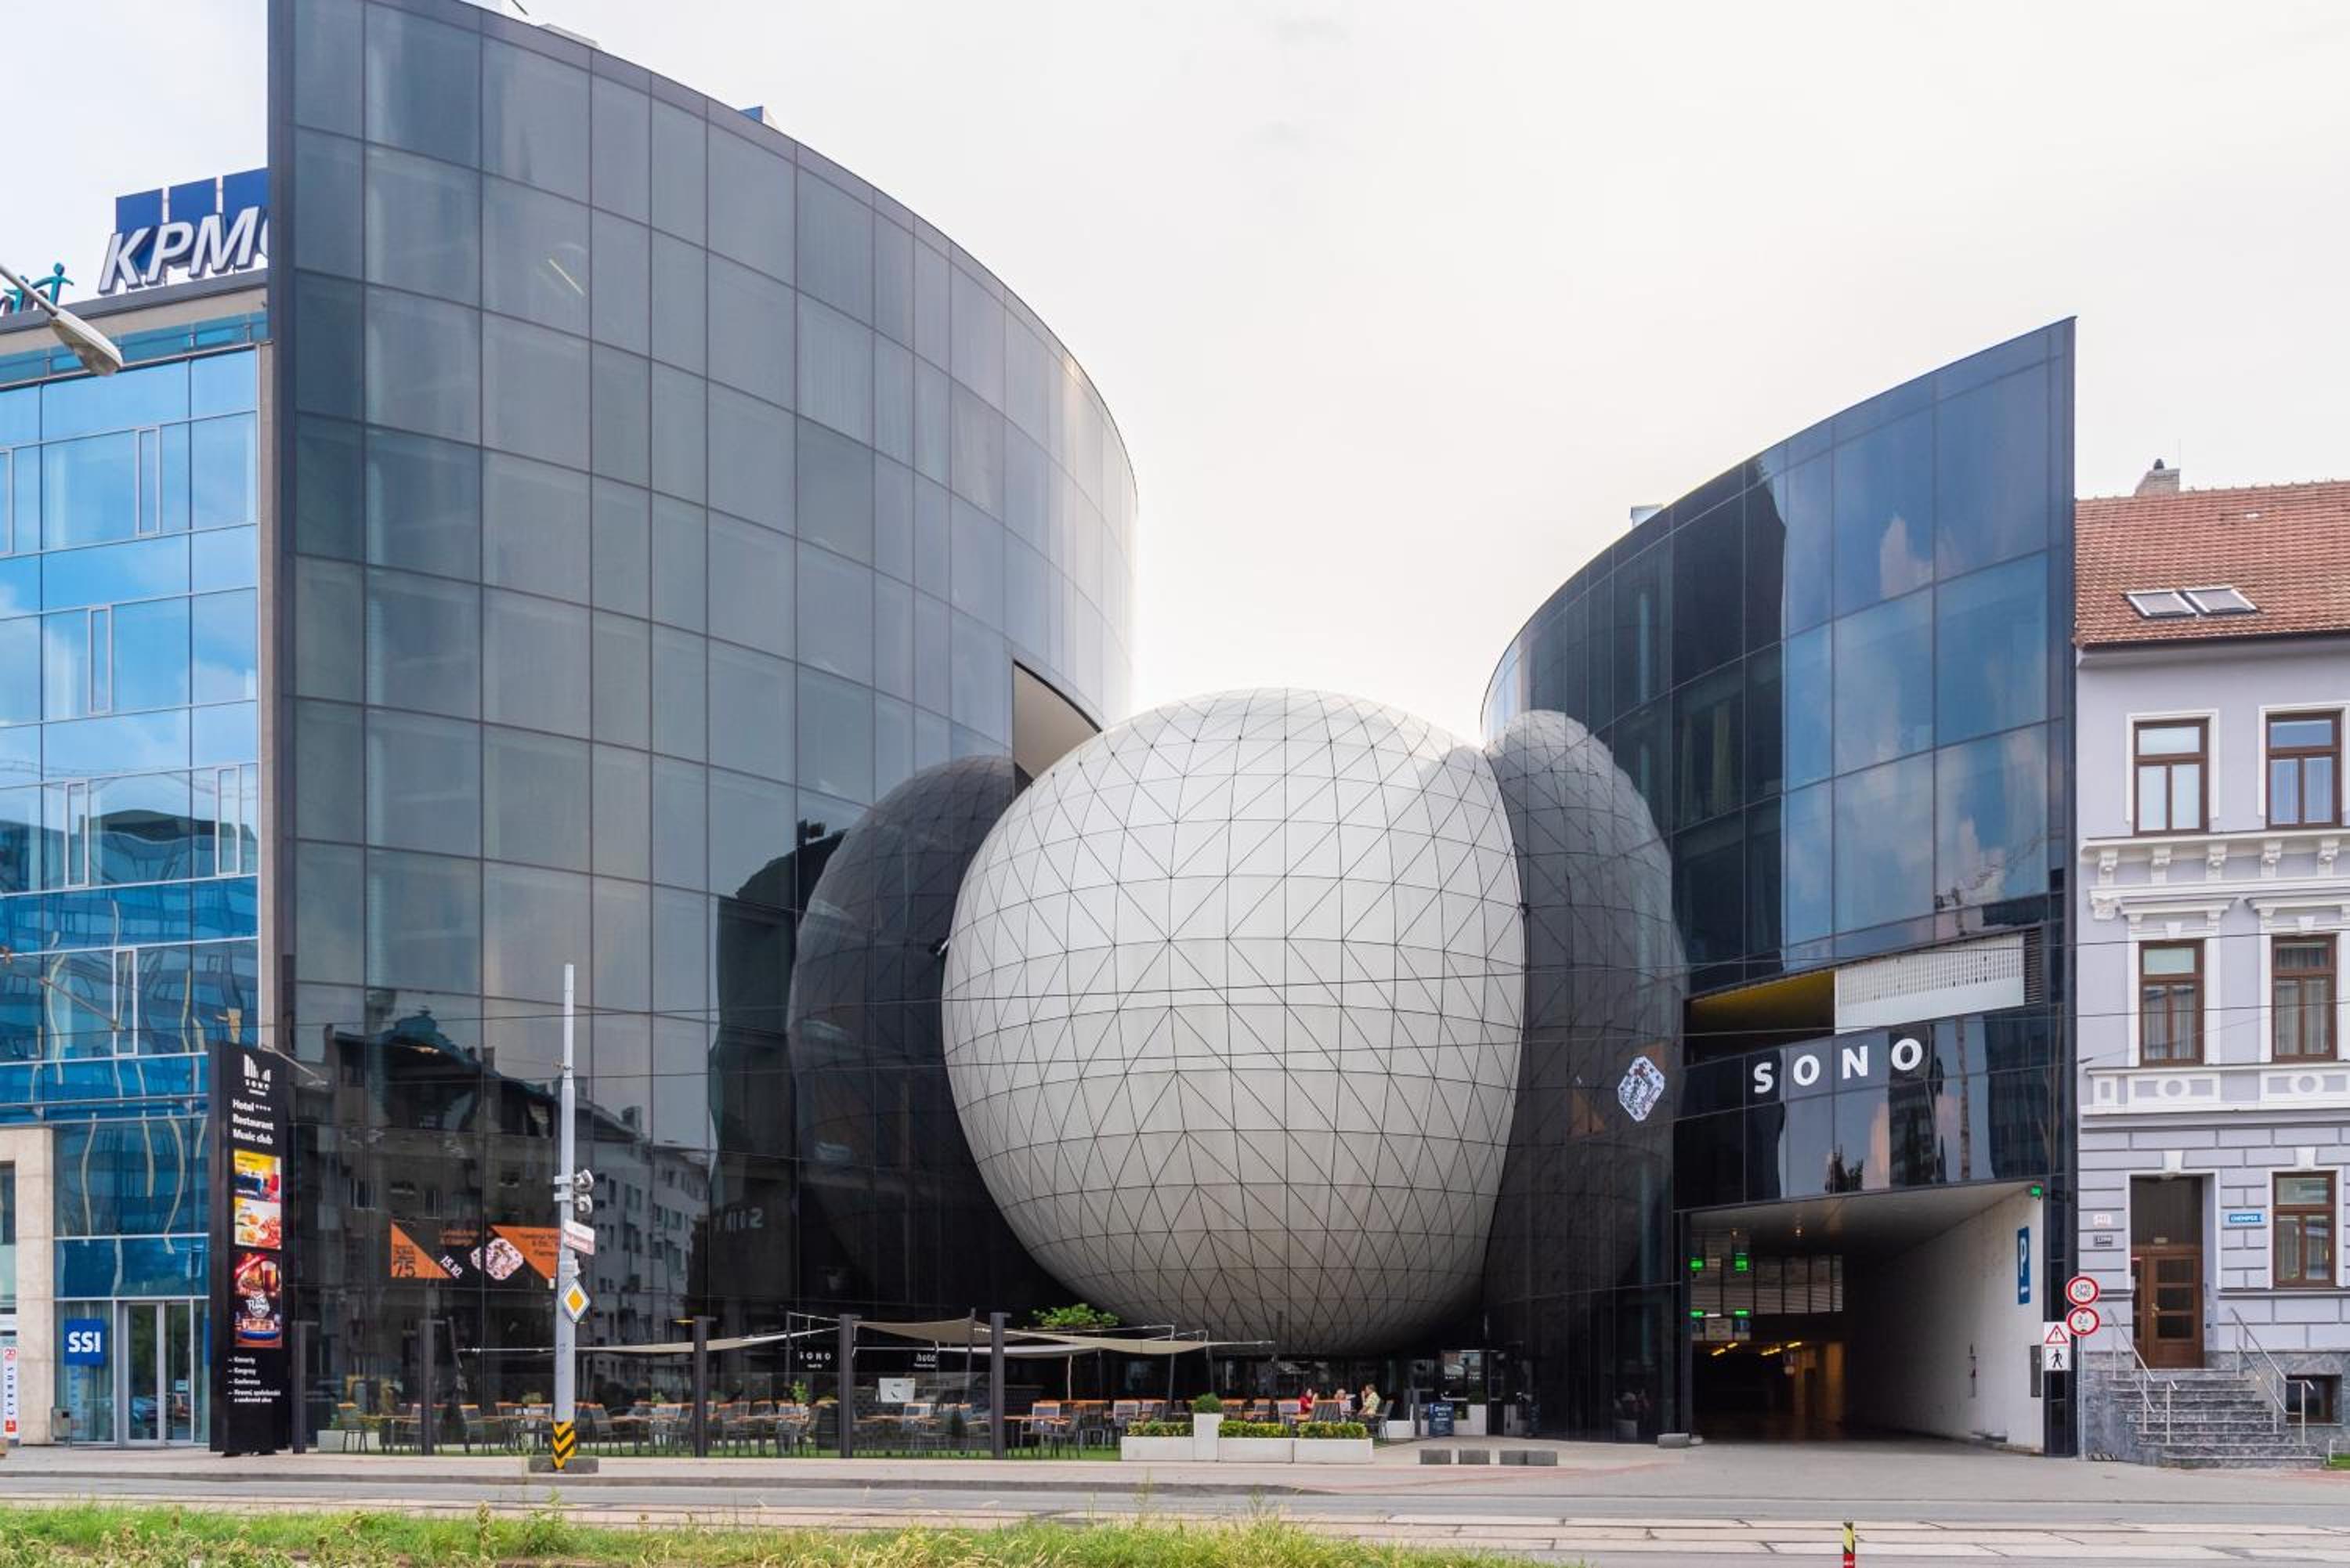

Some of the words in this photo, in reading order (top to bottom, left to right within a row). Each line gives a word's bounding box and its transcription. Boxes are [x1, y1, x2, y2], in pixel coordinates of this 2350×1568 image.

[99, 206, 268, 294] KPM
[1754, 1038, 1923, 1093] SONO
[245, 1078, 269, 1091] SONO
[233, 1098, 254, 1112] Hotel
[233, 1113, 273, 1130] Restaurant
[233, 1128, 255, 1141] Music
[257, 1133, 273, 1146] club
[68, 1331, 101, 1353] SSI
